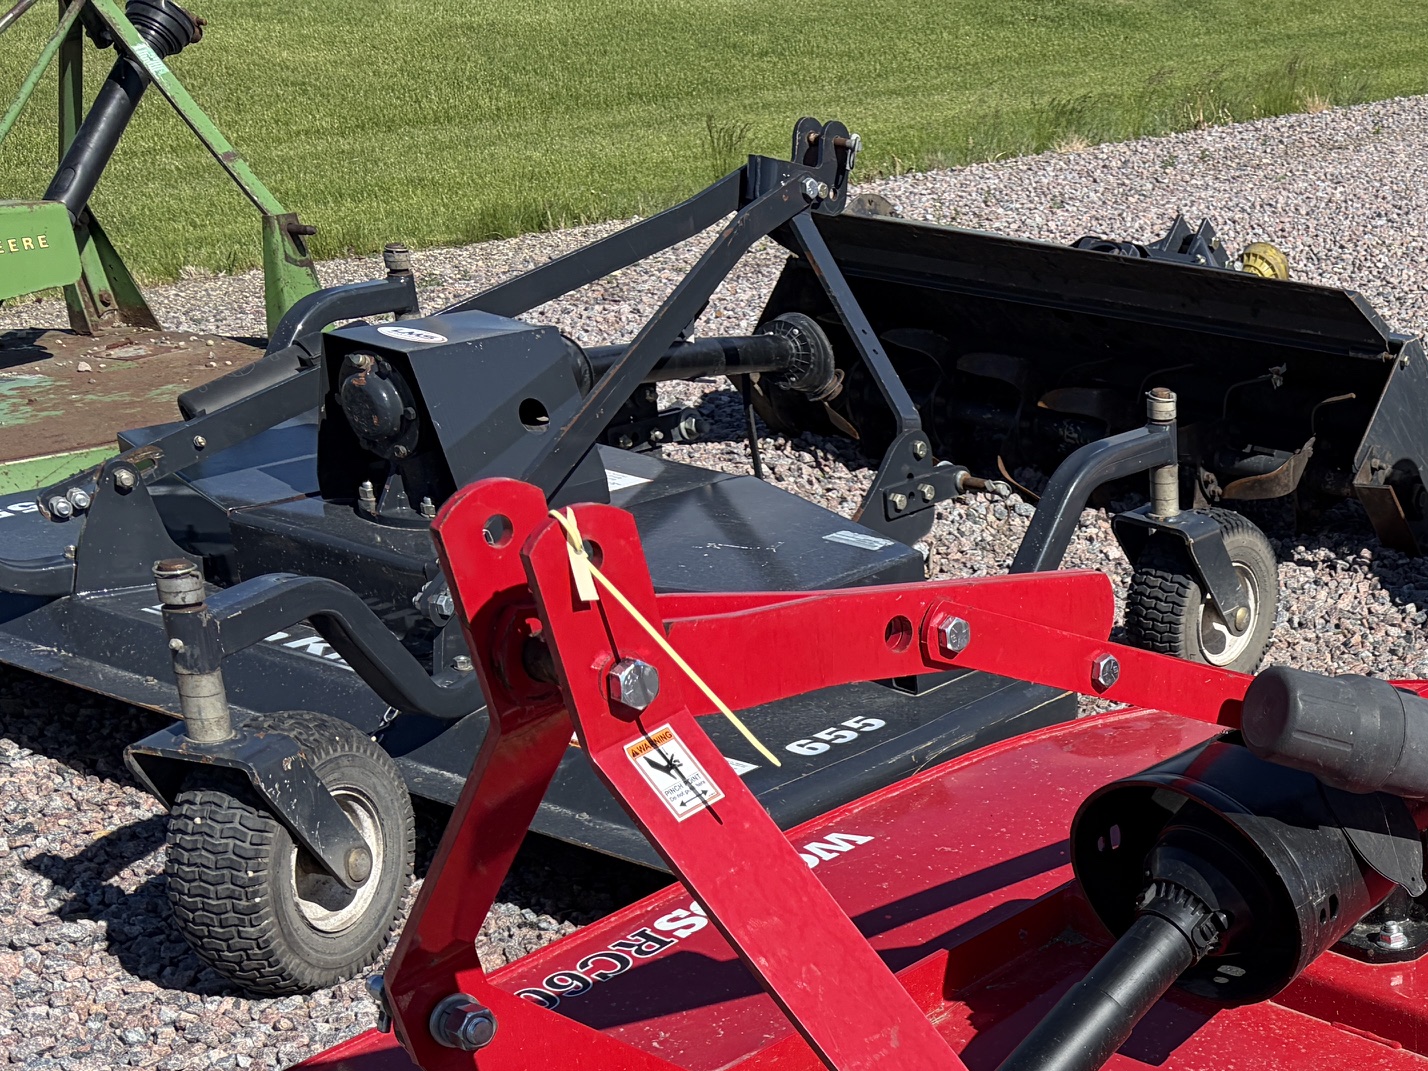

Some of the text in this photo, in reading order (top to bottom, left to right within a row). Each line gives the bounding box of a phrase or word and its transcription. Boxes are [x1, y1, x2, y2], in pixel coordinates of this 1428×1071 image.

[636, 731, 673, 753] WANING
[785, 715, 886, 756] 655
[664, 783, 683, 796] PINCH
